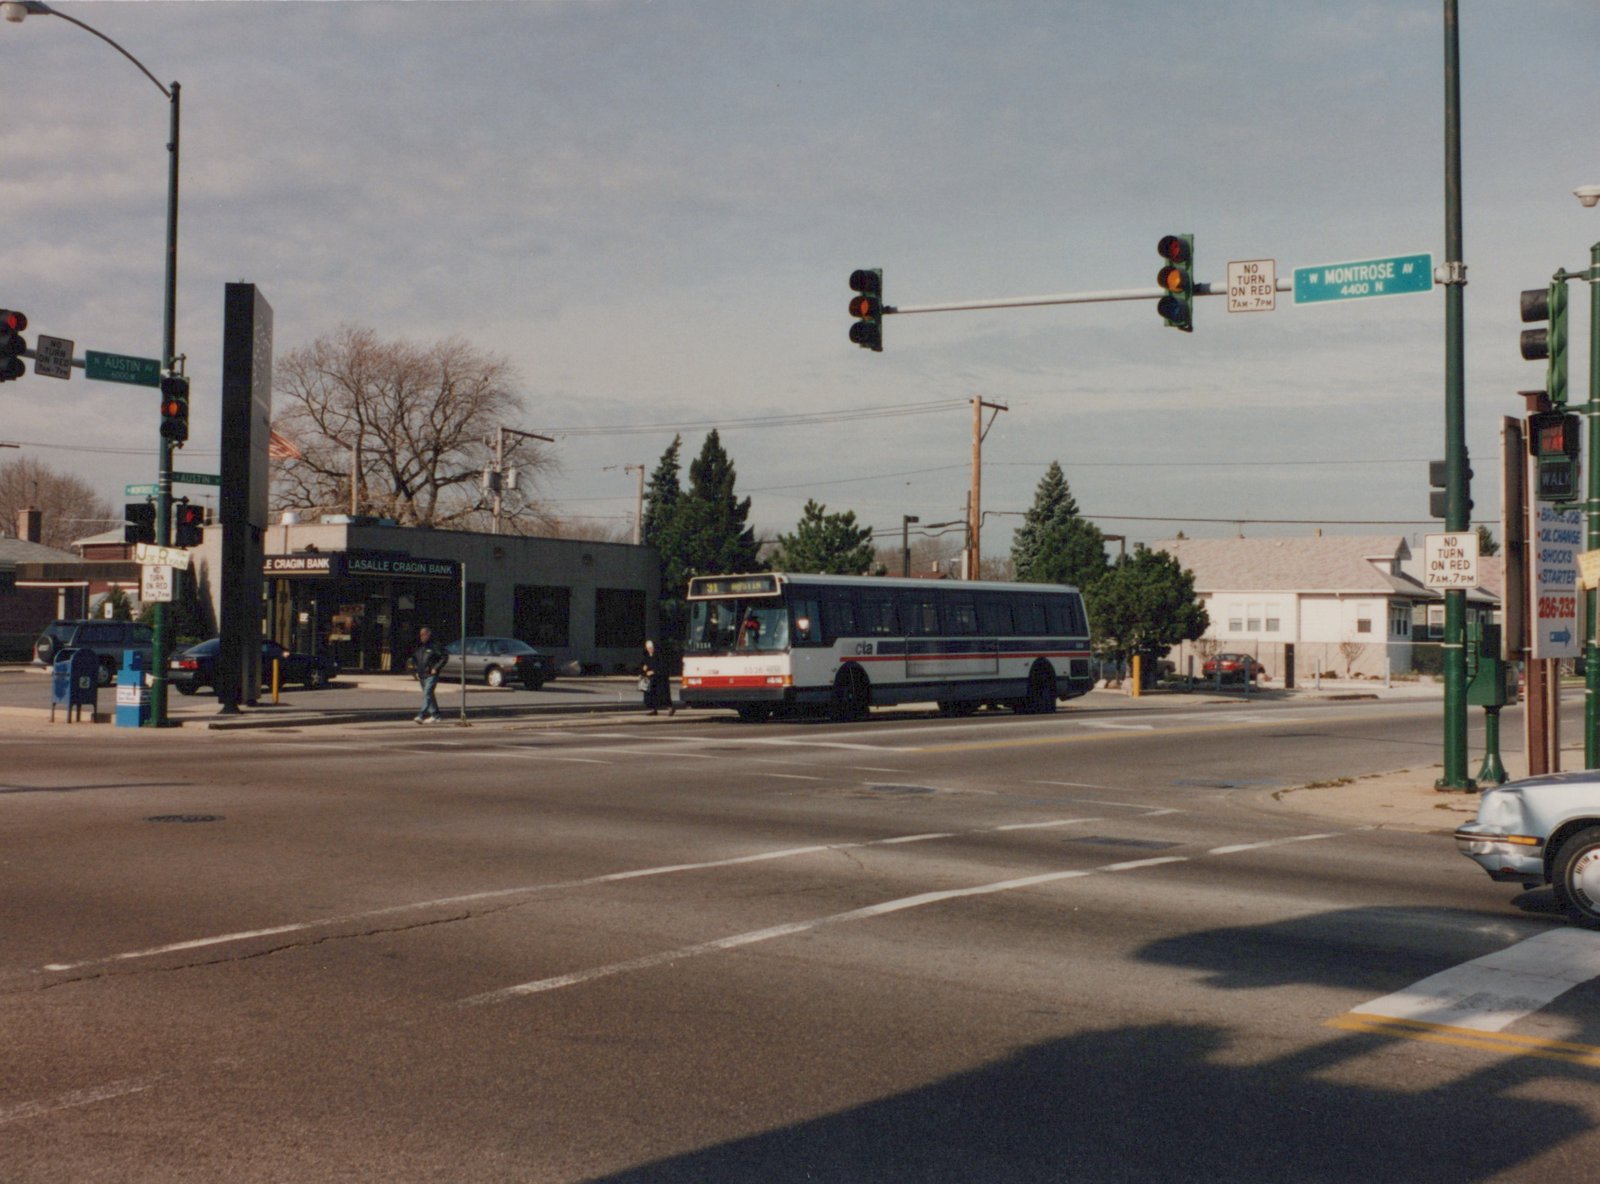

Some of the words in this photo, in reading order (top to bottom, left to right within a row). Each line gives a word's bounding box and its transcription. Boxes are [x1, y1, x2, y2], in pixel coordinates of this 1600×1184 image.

[1243, 263, 1258, 273] NO
[1309, 272, 1319, 284] W
[1324, 262, 1395, 285] MONTROSE
[1402, 263, 1414, 275] AV
[1237, 274, 1265, 285] TURN
[1231, 286, 1245, 296] ON
[1250, 285, 1272, 295] RED
[1340, 283, 1369, 295] 4400
[1374, 281, 1384, 292] N
[51, 339, 62, 348] NO
[45, 347, 66, 357] TURN
[38, 354, 49, 363] ON
[53, 357, 69, 367] RED
[104, 357, 141, 371] AUSTIN
[180, 473, 210, 484] AUSTIN
[1541, 471, 1570, 486] WALK
[1444, 536, 1458, 546] NO
[1541, 527, 1552, 542] OIL
[1553, 528, 1581, 545] CHANGE
[1437, 548, 1464, 558] TURN
[1542, 548, 1572, 563] SHOCKS
[274, 559, 305, 570] CRAGIN
[307, 558, 330, 568] BANK
[348, 559, 389, 571] LASALLE
[392, 561, 426, 573] CRAGIN
[429, 565, 452, 575] BANK
[1431, 560, 1444, 570] ON
[1450, 559, 1470, 570] RED
[1538, 597, 1577, 619] 286-232
